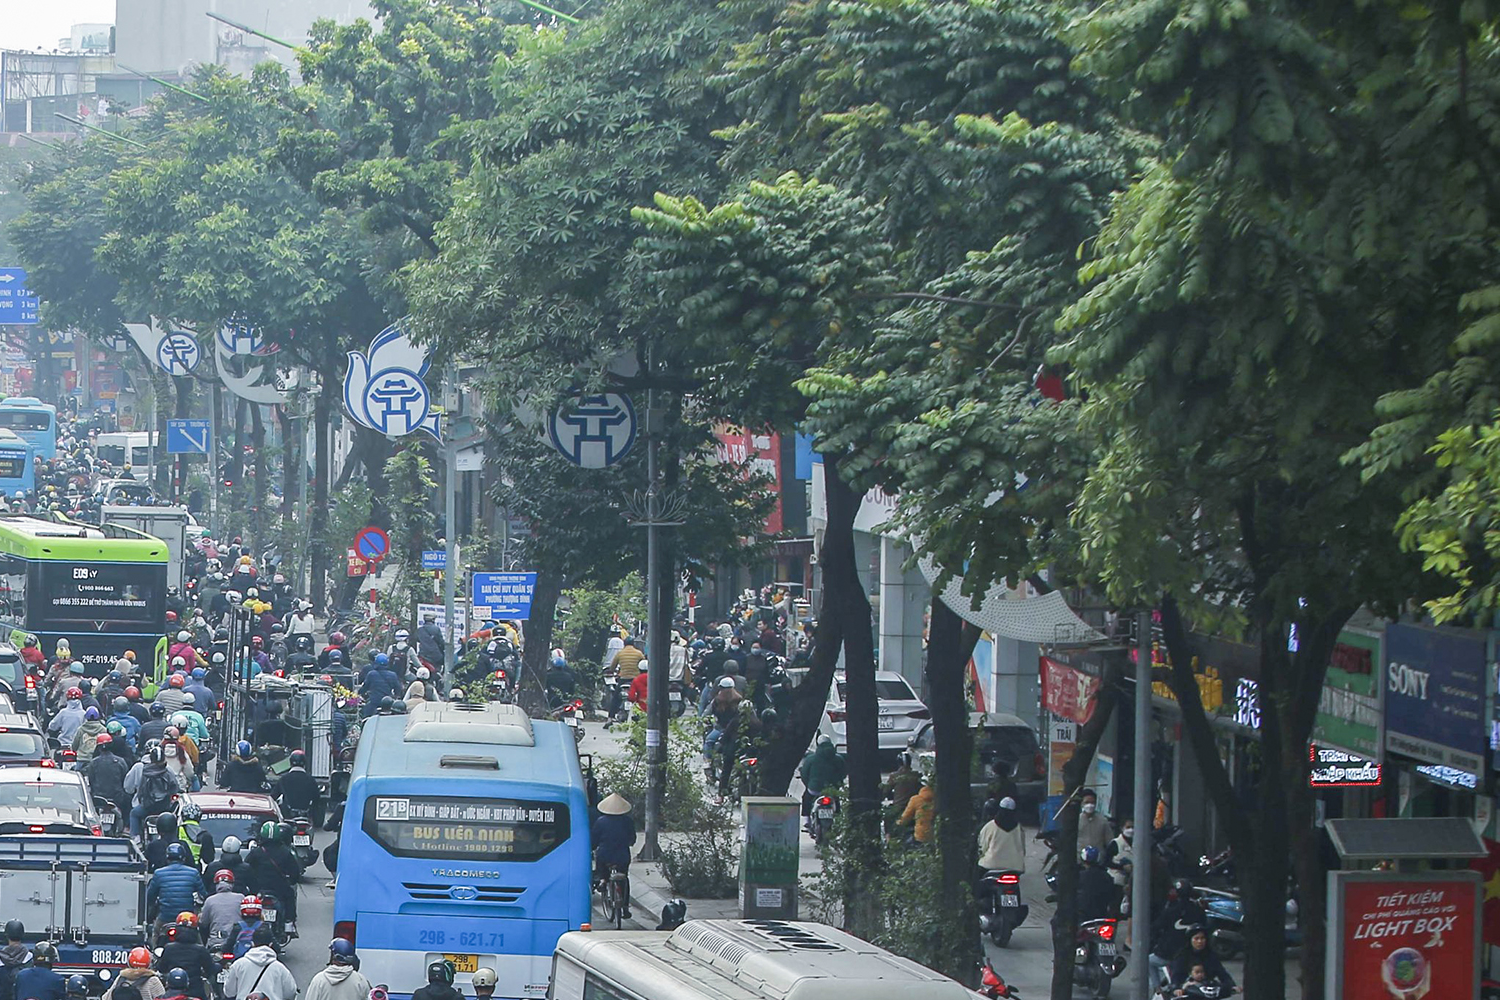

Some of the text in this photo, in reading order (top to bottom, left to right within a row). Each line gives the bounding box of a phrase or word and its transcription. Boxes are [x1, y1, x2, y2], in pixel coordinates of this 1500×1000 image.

[1389, 662, 1430, 700] SONY
[380, 801, 406, 817] 21B
[413, 826, 439, 840] BUS
[444, 825, 474, 842] LIÊN
[432, 868, 500, 880] TRACOMECO
[1377, 889, 1444, 908] TIẾT KIỆM
[1354, 915, 1459, 940] LIGHT BOX
[420, 930, 505, 947] 29B 621.71
